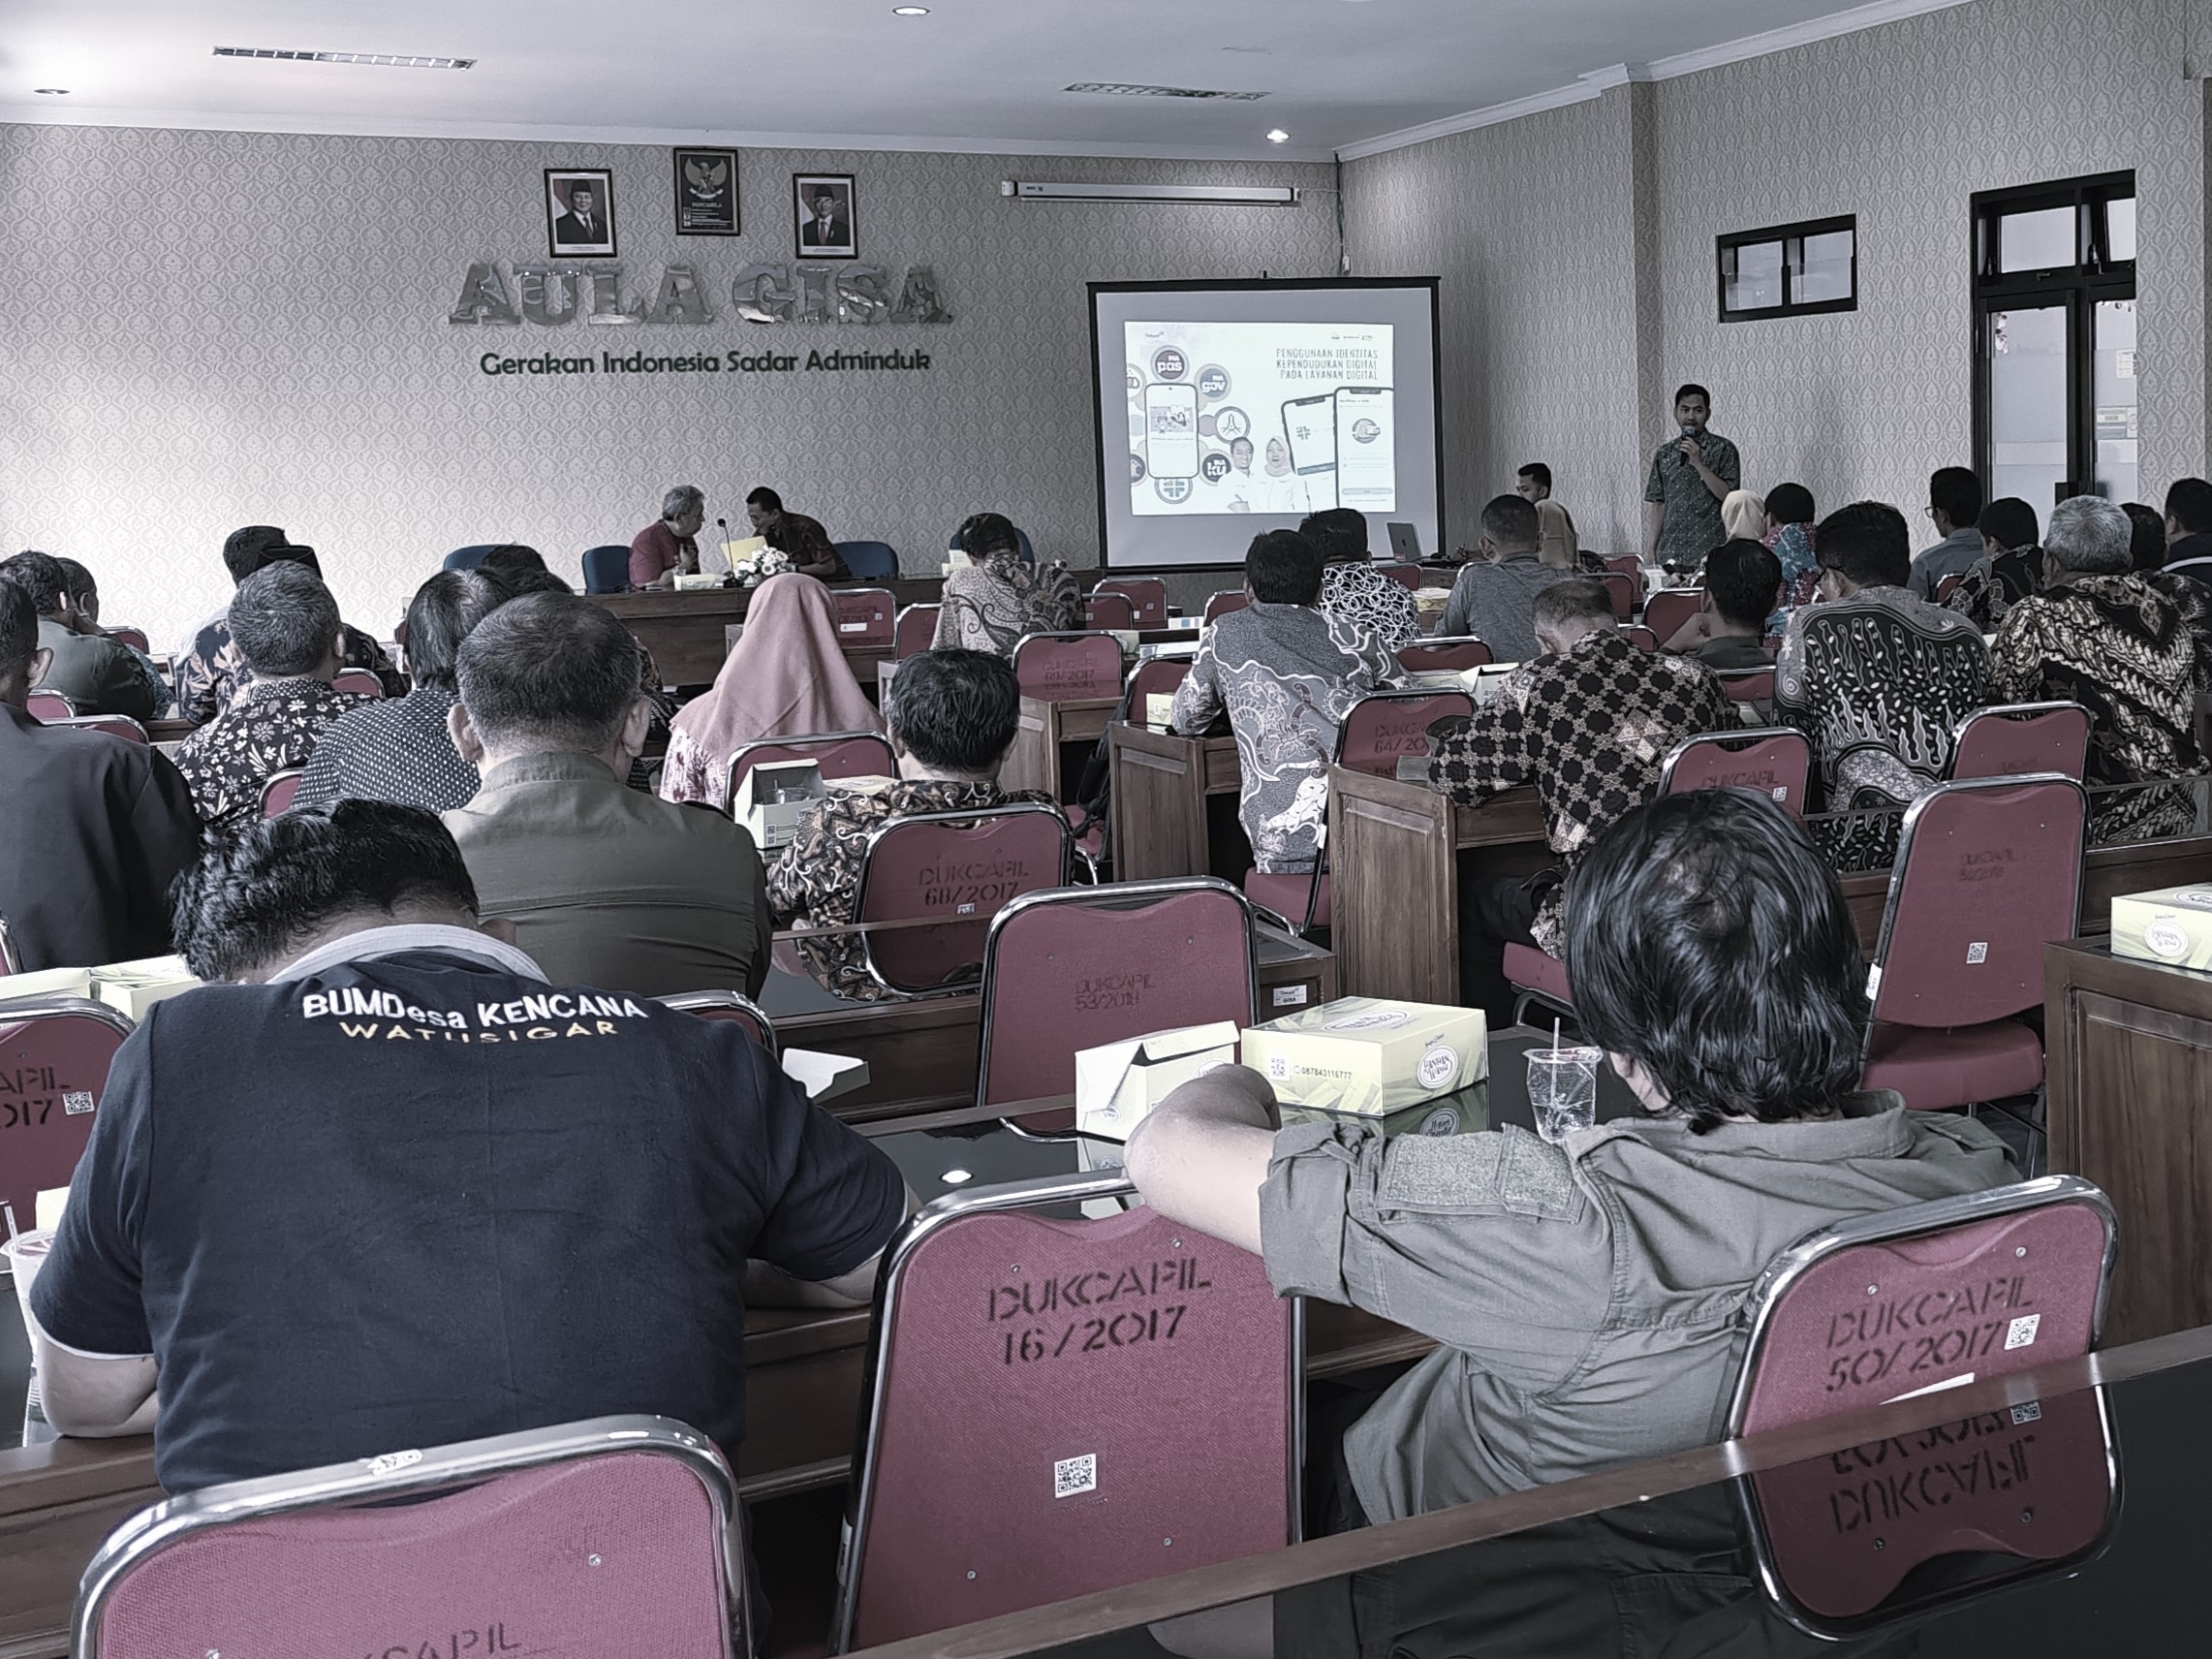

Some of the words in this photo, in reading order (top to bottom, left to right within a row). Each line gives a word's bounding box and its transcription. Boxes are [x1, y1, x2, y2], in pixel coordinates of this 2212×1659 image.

[449, 264, 715, 325] AULA
[732, 264, 953, 325] GISA
[480, 352, 595, 375] Gerakan
[602, 350, 719, 374] Indonesia
[727, 349, 798, 373] Sadar
[805, 348, 930, 371] Adminduk
[1276, 349, 1333, 359] PENGGUNAAN
[1336, 349, 1378, 359] IDENTITAS
[1276, 360, 1343, 369] KEPENDUDUKAN
[1346, 360, 1377, 370] DIGITAL
[1280, 370, 1302, 380] PADA
[1305, 370, 1343, 380] LAYANAN
[1346, 370, 1378, 380] DIGITAL
[919, 861, 1030, 886] DUKCAPIL
[302, 986, 468, 1029] BUMDesa
[477, 993, 649, 1027] KENCANA
[988, 1258, 1211, 1322] DUKCAPIL
[1827, 1275, 2033, 1349] DUKCAPIL
[1003, 1304, 1188, 1365] 16/2017
[1825, 1321, 2004, 1392] 50/2017
